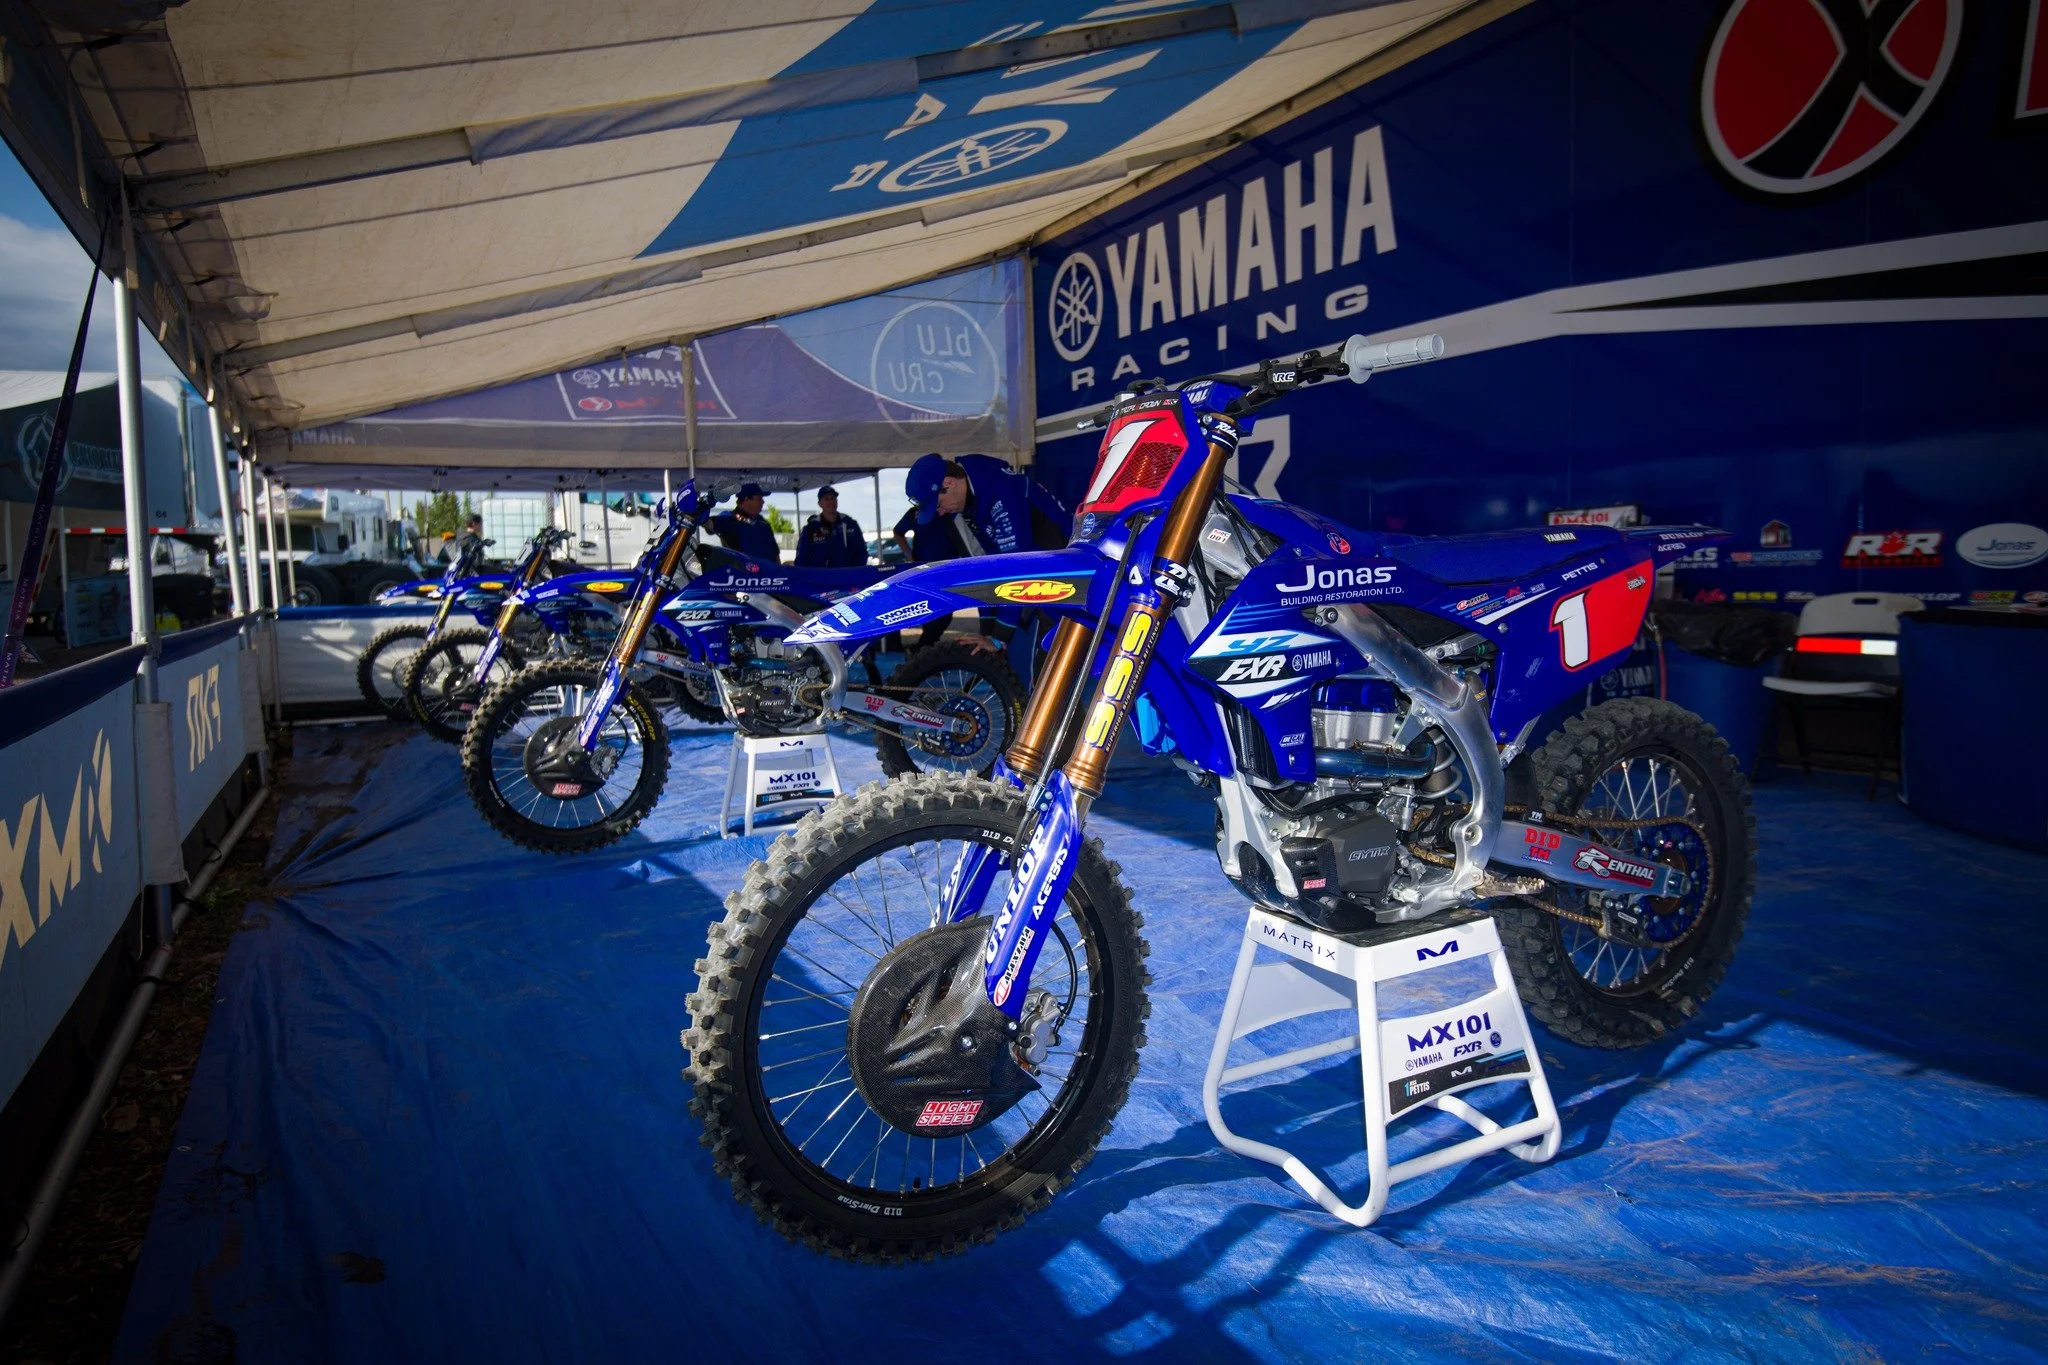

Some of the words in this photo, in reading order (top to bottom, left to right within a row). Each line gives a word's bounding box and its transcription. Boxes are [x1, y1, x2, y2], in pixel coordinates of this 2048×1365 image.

[1106, 126, 1397, 338] YAMAHA
[1071, 284, 1369, 391] RACING
[1087, 420, 1156, 502] 1
[1544, 532, 1576, 543] YAMAHA
[708, 575, 789, 587] Jonas
[1275, 565, 1397, 593] Jonas
[1561, 562, 1598, 582] PETTIS
[996, 581, 1075, 600] FMF
[1281, 592, 1323, 606] BUILDING
[1324, 587, 1383, 603] RESTORATION
[676, 609, 712, 620] FXR
[880, 602, 928, 620] WORKS
[1553, 592, 1589, 668] 1
[1216, 654, 1287, 682] FXR
[1302, 650, 1332, 669] YAMAHA
[1083, 609, 1154, 748] SSS
[769, 771, 816, 784] MX101
[1348, 844, 1392, 863] GYTR
[1575, 848, 1654, 881] RENTHAL
[1263, 924, 1336, 961] MATRIX
[1407, 1012, 1492, 1053] MX101
[1413, 1051, 1443, 1069] YAMAHA
[1453, 1040, 1483, 1058] FXR
[1409, 1081, 1431, 1096] PETTIS
[925, 1100, 983, 1114] LIGHT
[917, 1112, 976, 1126] SPEED
[883, 1207, 903, 1217] DID
